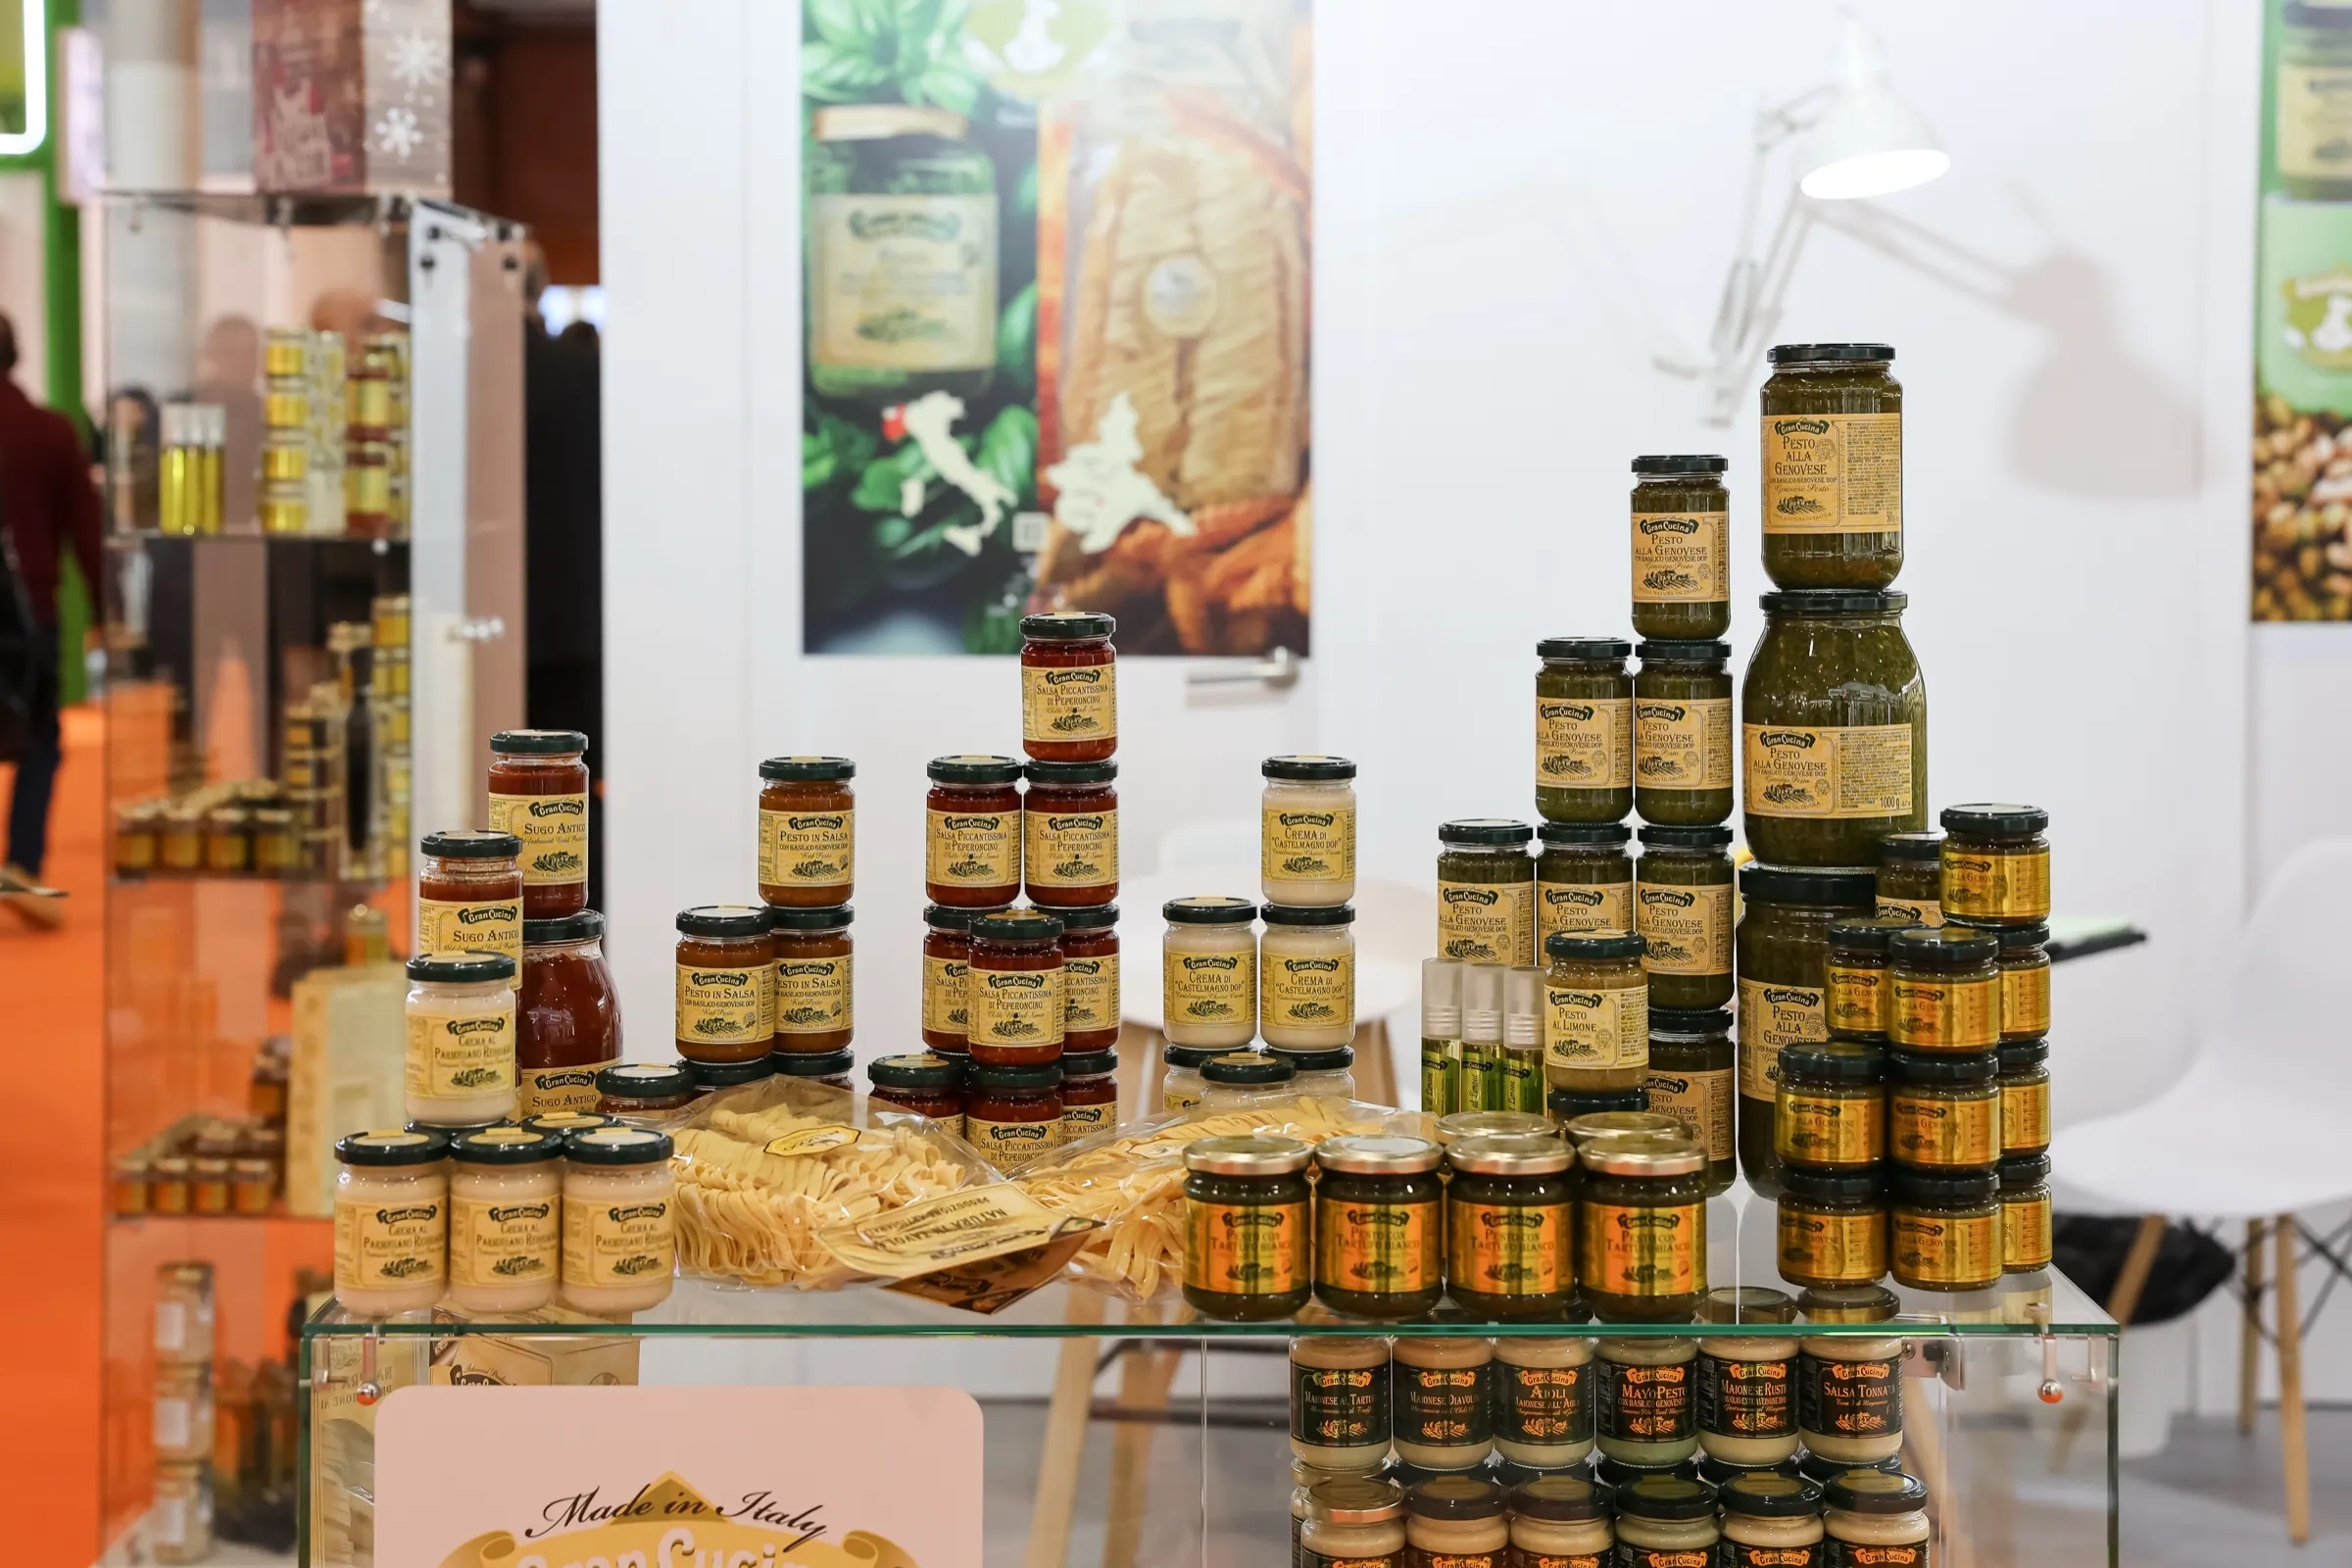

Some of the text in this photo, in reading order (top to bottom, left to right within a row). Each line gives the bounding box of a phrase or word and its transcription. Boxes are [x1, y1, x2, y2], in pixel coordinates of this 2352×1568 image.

[1783, 436, 1815, 449] PESTO
[1786, 451, 1812, 462] ALLA
[1775, 462, 1827, 475] GENOVESE
[1651, 534, 1683, 544] PESTO
[1655, 545, 1707, 556] GENOVESE
[1037, 684, 1107, 695] SALSA PICCANTISSIMA
[1055, 696, 1101, 706] PEPERONCINO
[1548, 719, 1578, 730] PESTO
[1642, 720, 1669, 731] PESTO
[1551, 731, 1602, 742] GENOVESE
[1645, 732, 1694, 742] GENOVESE
[1770, 748, 1800, 760] PESTO
[1754, 760, 1827, 771] ALLA GENOVESE
[1880, 797, 1895, 808] 1000
[524, 823, 554, 835] SUGO
[936, 829, 956, 840] SALSA
[1285, 827, 1317, 840] CREMA
[780, 830, 808, 842] PESTO
[822, 831, 848, 841] SALSA
[1040, 830, 1061, 841] SALSA
[952, 841, 998, 851] PEPERONCINO
[1057, 841, 1102, 851] PEPERONCINO
[1452, 904, 1482, 914] PESTO
[1556, 905, 1588, 915] PESTO
[1649, 905, 1678, 916] PESTO
[1456, 914, 1506, 925] GENOVESE
[1560, 915, 1611, 926] GENOVESE
[1652, 915, 1703, 927] GENOVESE
[453, 930, 519, 942] SUGO ANTICO
[936, 977, 956, 987] SALSA
[1189, 971, 1221, 983] CREMA
[1291, 973, 1323, 986] CREMA
[811, 978, 841, 988] SALSA
[685, 986, 710, 999] PESTO
[723, 986, 755, 999] SALSA
[980, 987, 1001, 998] SALSA
[997, 1000, 1043, 1010] PEPERONCINO
[1559, 1007, 1587, 1019] PESTO
[1773, 1005, 1805, 1021] PESTO
[1563, 1019, 1596, 1031] LIMONE
[1776, 1021, 1801, 1034] ALLA
[532, 1094, 597, 1107] SUGO ANTICO
[981, 1138, 1003, 1151] SALSA
[524, 1483, 655, 1538] Made
[663, 1492, 709, 1515] in
[715, 1491, 827, 1553] Italy
